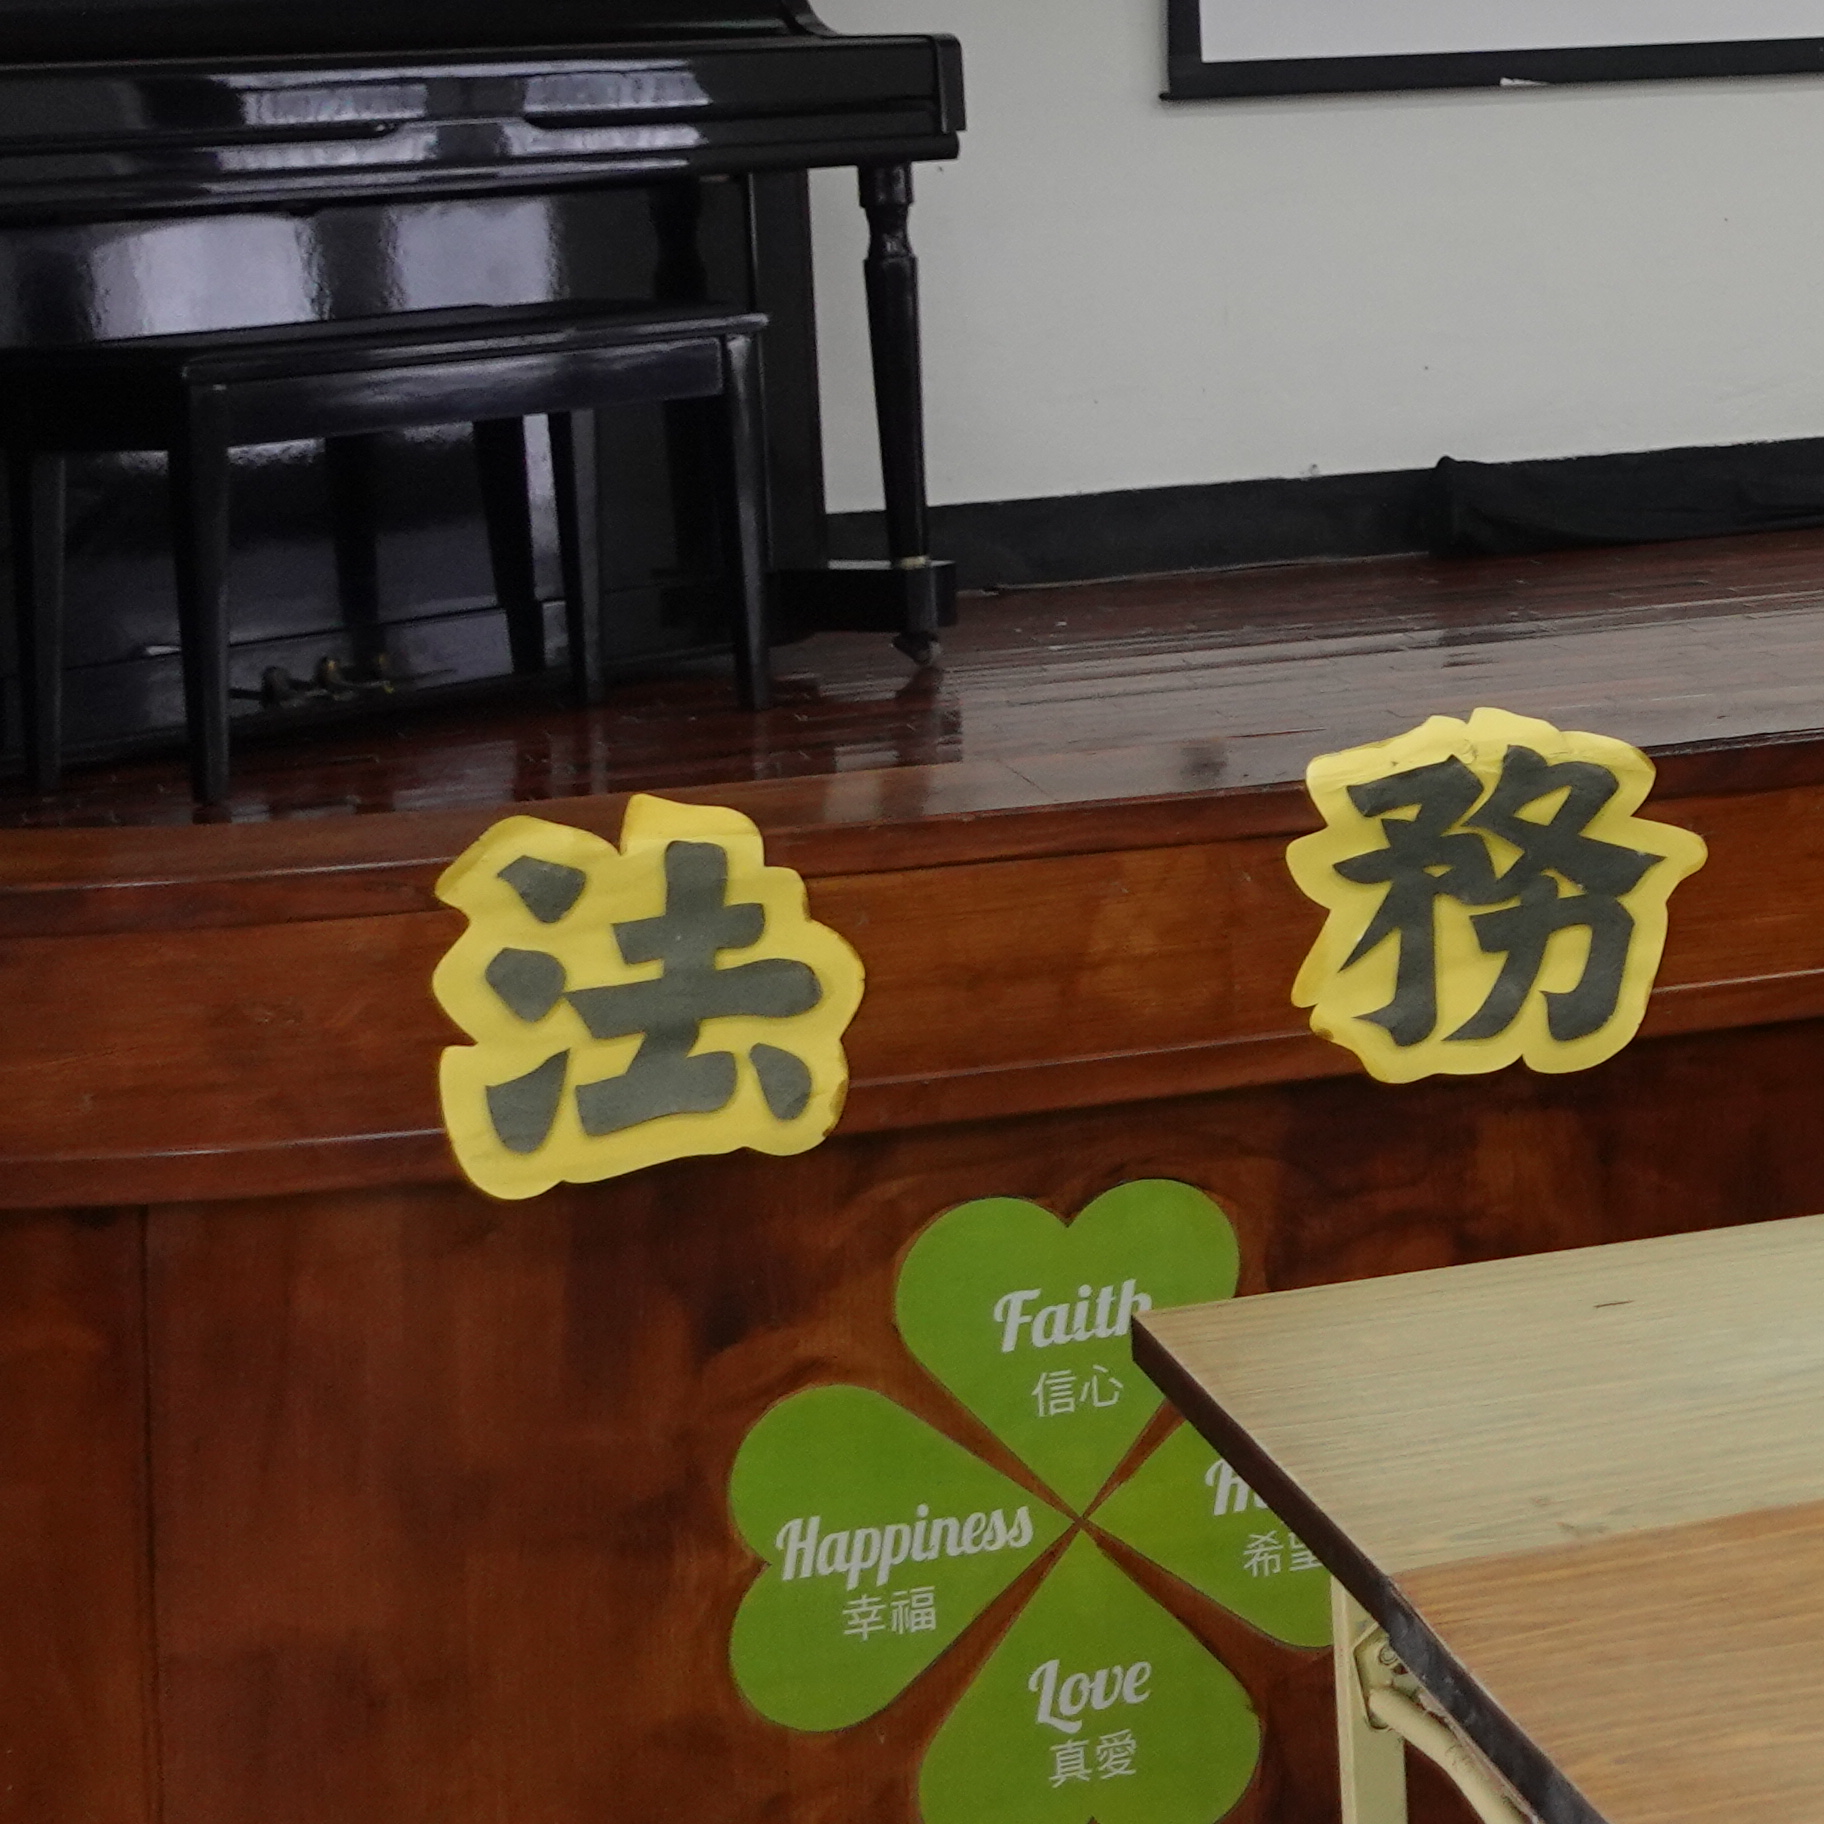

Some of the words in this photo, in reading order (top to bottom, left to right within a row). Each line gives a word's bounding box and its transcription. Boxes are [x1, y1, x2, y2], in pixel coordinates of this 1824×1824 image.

[993, 1278, 1153, 1353] Faith
[1031, 1364, 1124, 1418] 信心
[775, 1504, 1034, 1590] Happiness
[842, 1585, 937, 1641] 幸福
[1028, 1659, 1152, 1734] Love
[1049, 1728, 1138, 1788] 真愛
